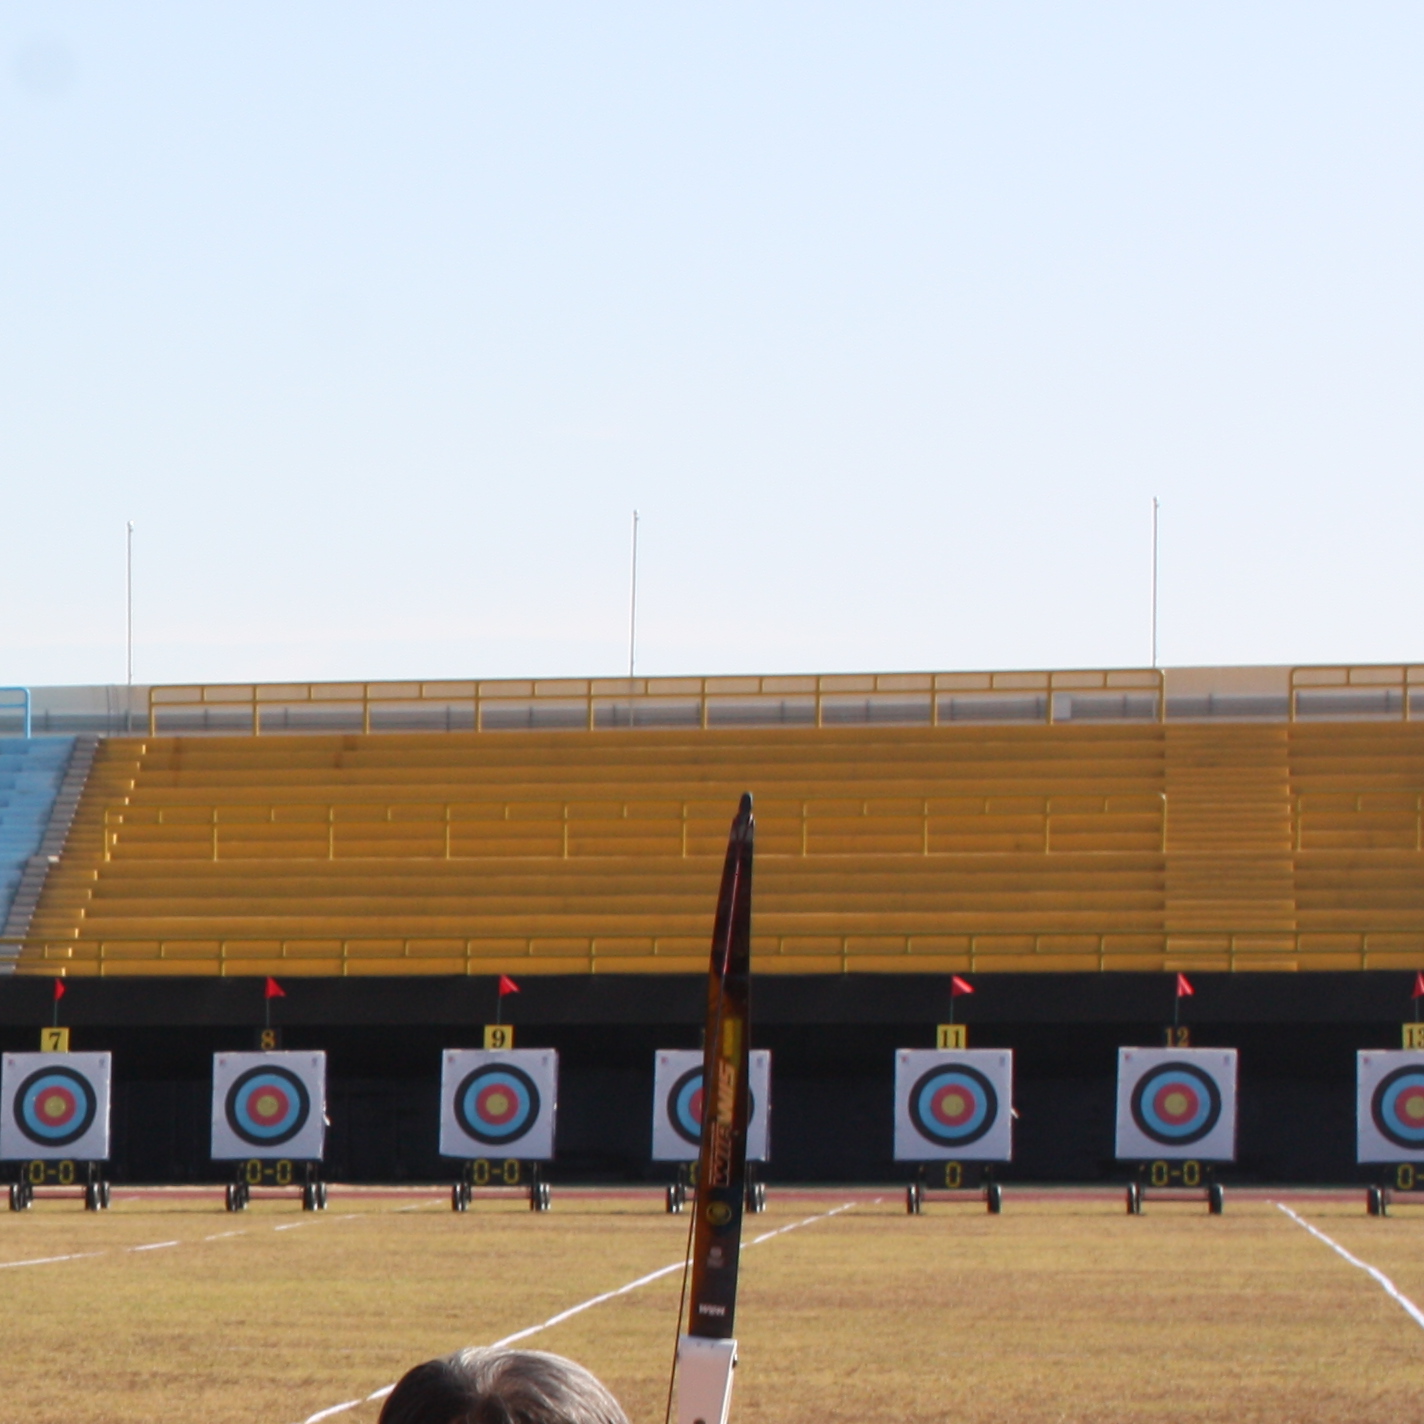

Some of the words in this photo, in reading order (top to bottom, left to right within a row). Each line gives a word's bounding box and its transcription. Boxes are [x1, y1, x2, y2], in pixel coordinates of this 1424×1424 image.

[48, 1031, 62, 1051] 7
[260, 1029, 276, 1050] 8
[490, 1028, 506, 1049] 9
[940, 1028, 962, 1048] 11
[1165, 1027, 1191, 1048] 12
[29, 1160, 76, 1185] 0-0
[245, 1159, 293, 1185] 0-0
[473, 1159, 521, 1185] 0-0
[944, 1160, 963, 1188] 0
[1151, 1160, 1201, 1186] 0-0
